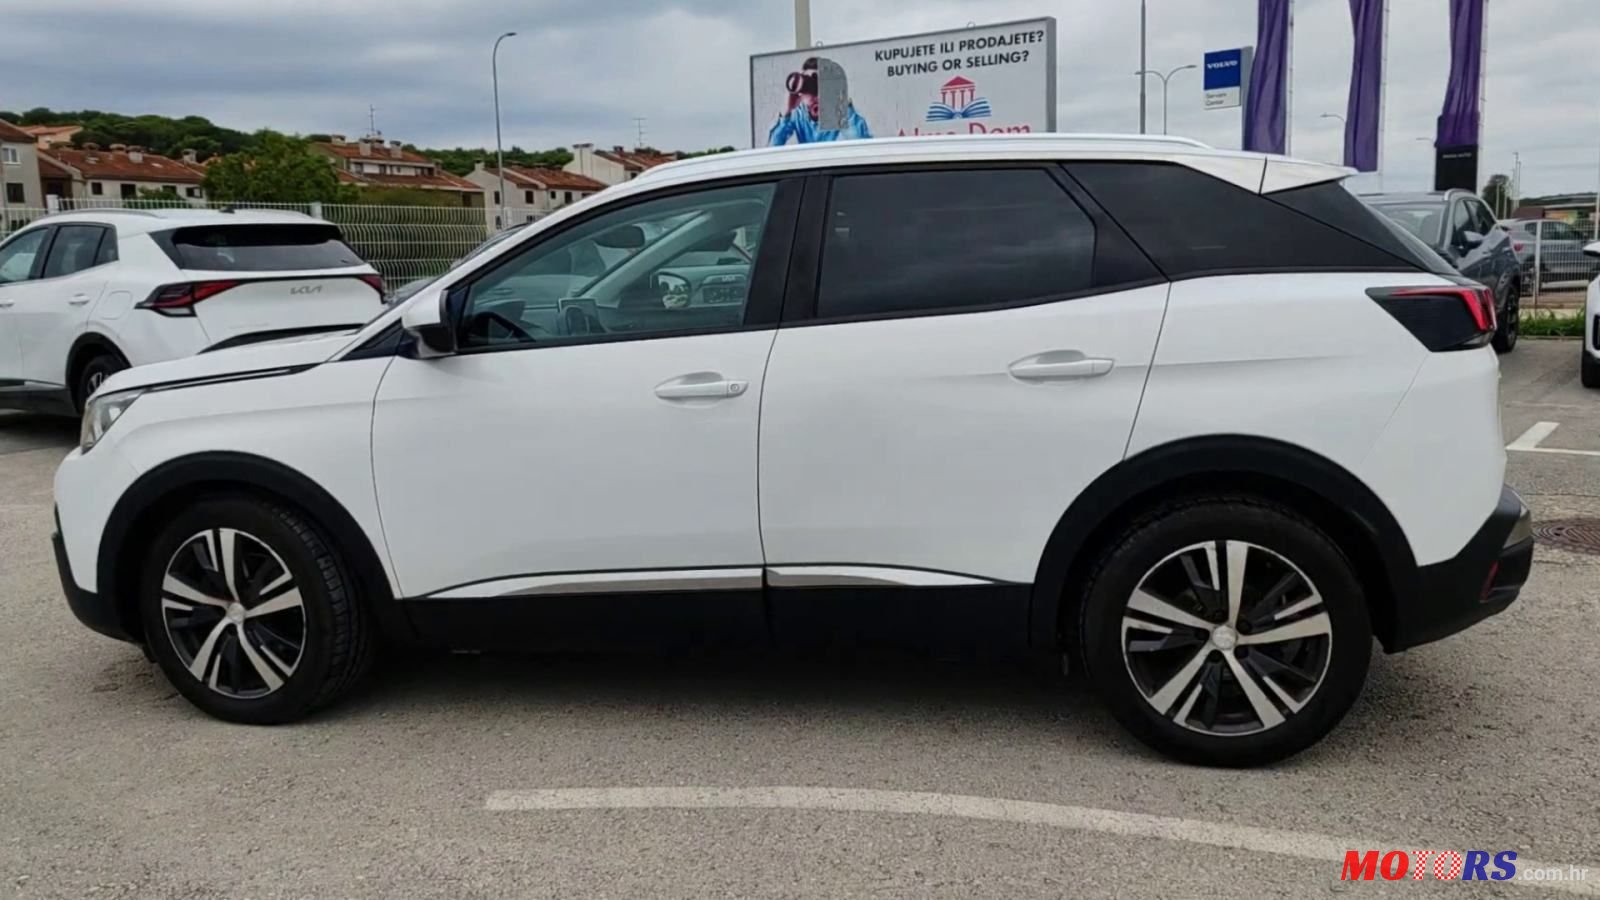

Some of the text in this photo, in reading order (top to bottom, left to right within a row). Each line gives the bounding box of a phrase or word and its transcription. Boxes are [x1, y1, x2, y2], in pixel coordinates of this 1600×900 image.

[875, 30, 1044, 61] KUPUJETE ILI PRODAJETE?
[887, 50, 1029, 77] BUYING OR SELLING?
[1207, 60, 1238, 69] VOLVO
